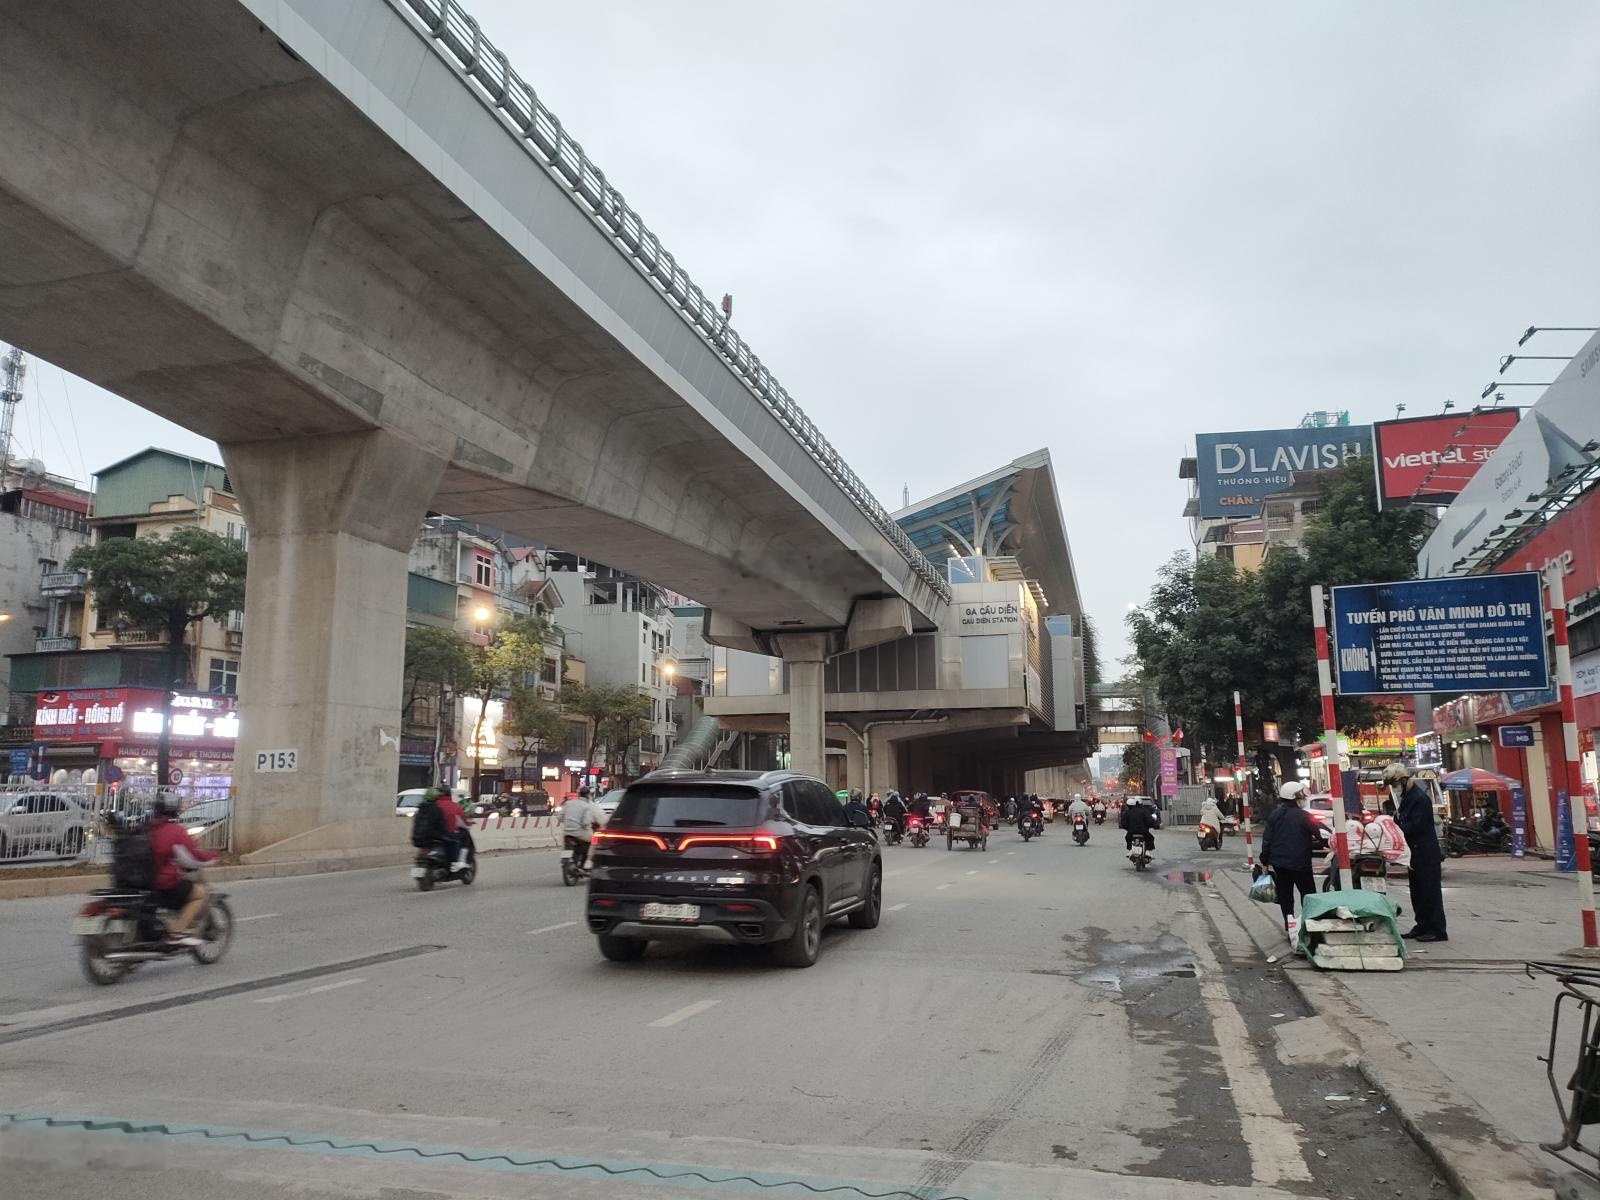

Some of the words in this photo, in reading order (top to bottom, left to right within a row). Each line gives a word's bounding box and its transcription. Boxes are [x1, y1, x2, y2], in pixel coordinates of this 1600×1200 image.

[1384, 447, 1466, 468] viettel
[1265, 476, 1287, 484] HIỆU
[965, 608, 977, 616] GA
[1346, 607, 1386, 625] TUYẾN
[1389, 605, 1416, 623] PHỐ
[1418, 606, 1445, 621] VĂN
[1449, 605, 1484, 619] MINH
[1487, 602, 1506, 618] ĐÔ
[1509, 602, 1532, 618] THỊ
[1340, 643, 1370, 672] KHÔNG
[36, 706, 58, 726] KÍNH
[257, 752, 296, 770] P153
